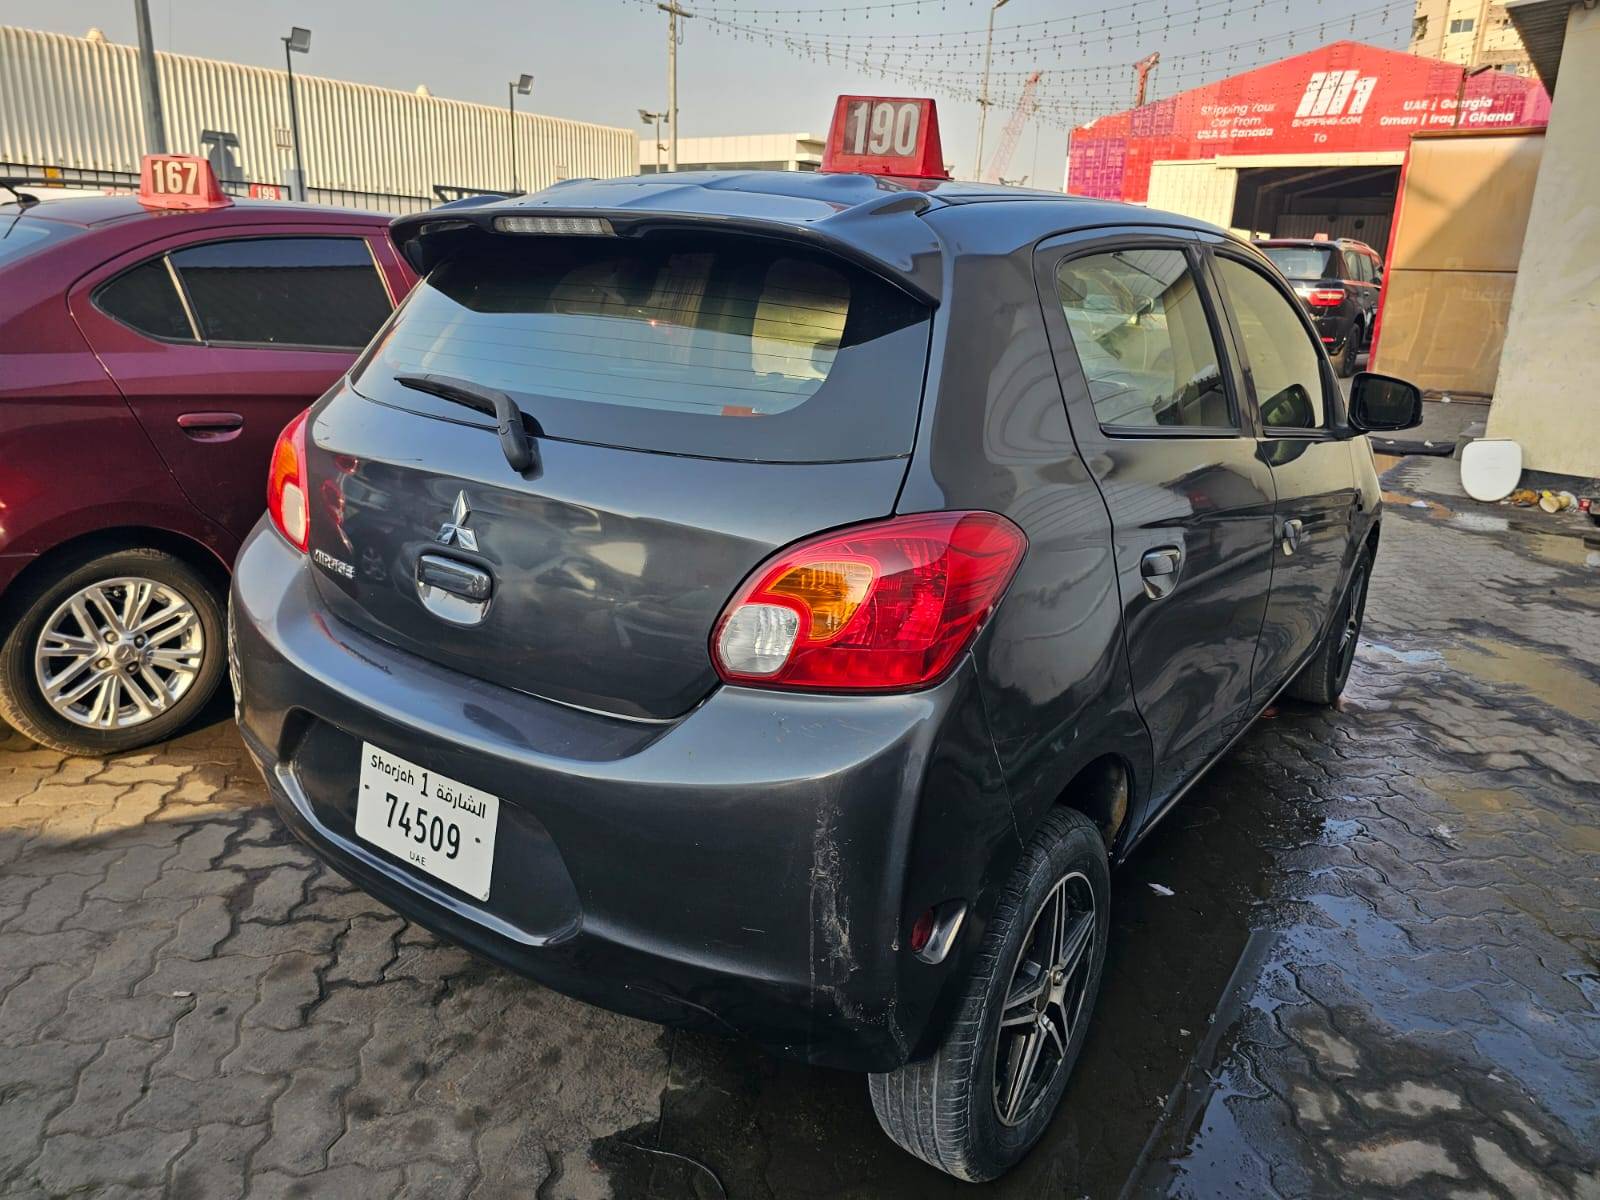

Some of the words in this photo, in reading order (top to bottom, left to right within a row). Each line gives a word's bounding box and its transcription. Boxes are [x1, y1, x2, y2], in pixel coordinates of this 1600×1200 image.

[1200, 105, 1249, 117] Shipping
[1403, 100, 1429, 111] UAE
[1211, 118, 1231, 127] Car
[1233, 117, 1263, 127] From
[1380, 116, 1418, 126] Oman
[1429, 114, 1456, 126] Iraq
[1469, 112, 1515, 123] Ghana
[854, 102, 919, 155] 190
[1231, 128, 1274, 138] Canada
[1313, 133, 1328, 143] To
[153, 160, 198, 194] 167
[370, 754, 414, 786] Sharjah
[420, 772, 429, 797] 1
[436, 783, 486, 819] الشارقة
[386, 792, 461, 859] 74509
[409, 851, 427, 866] UAE
